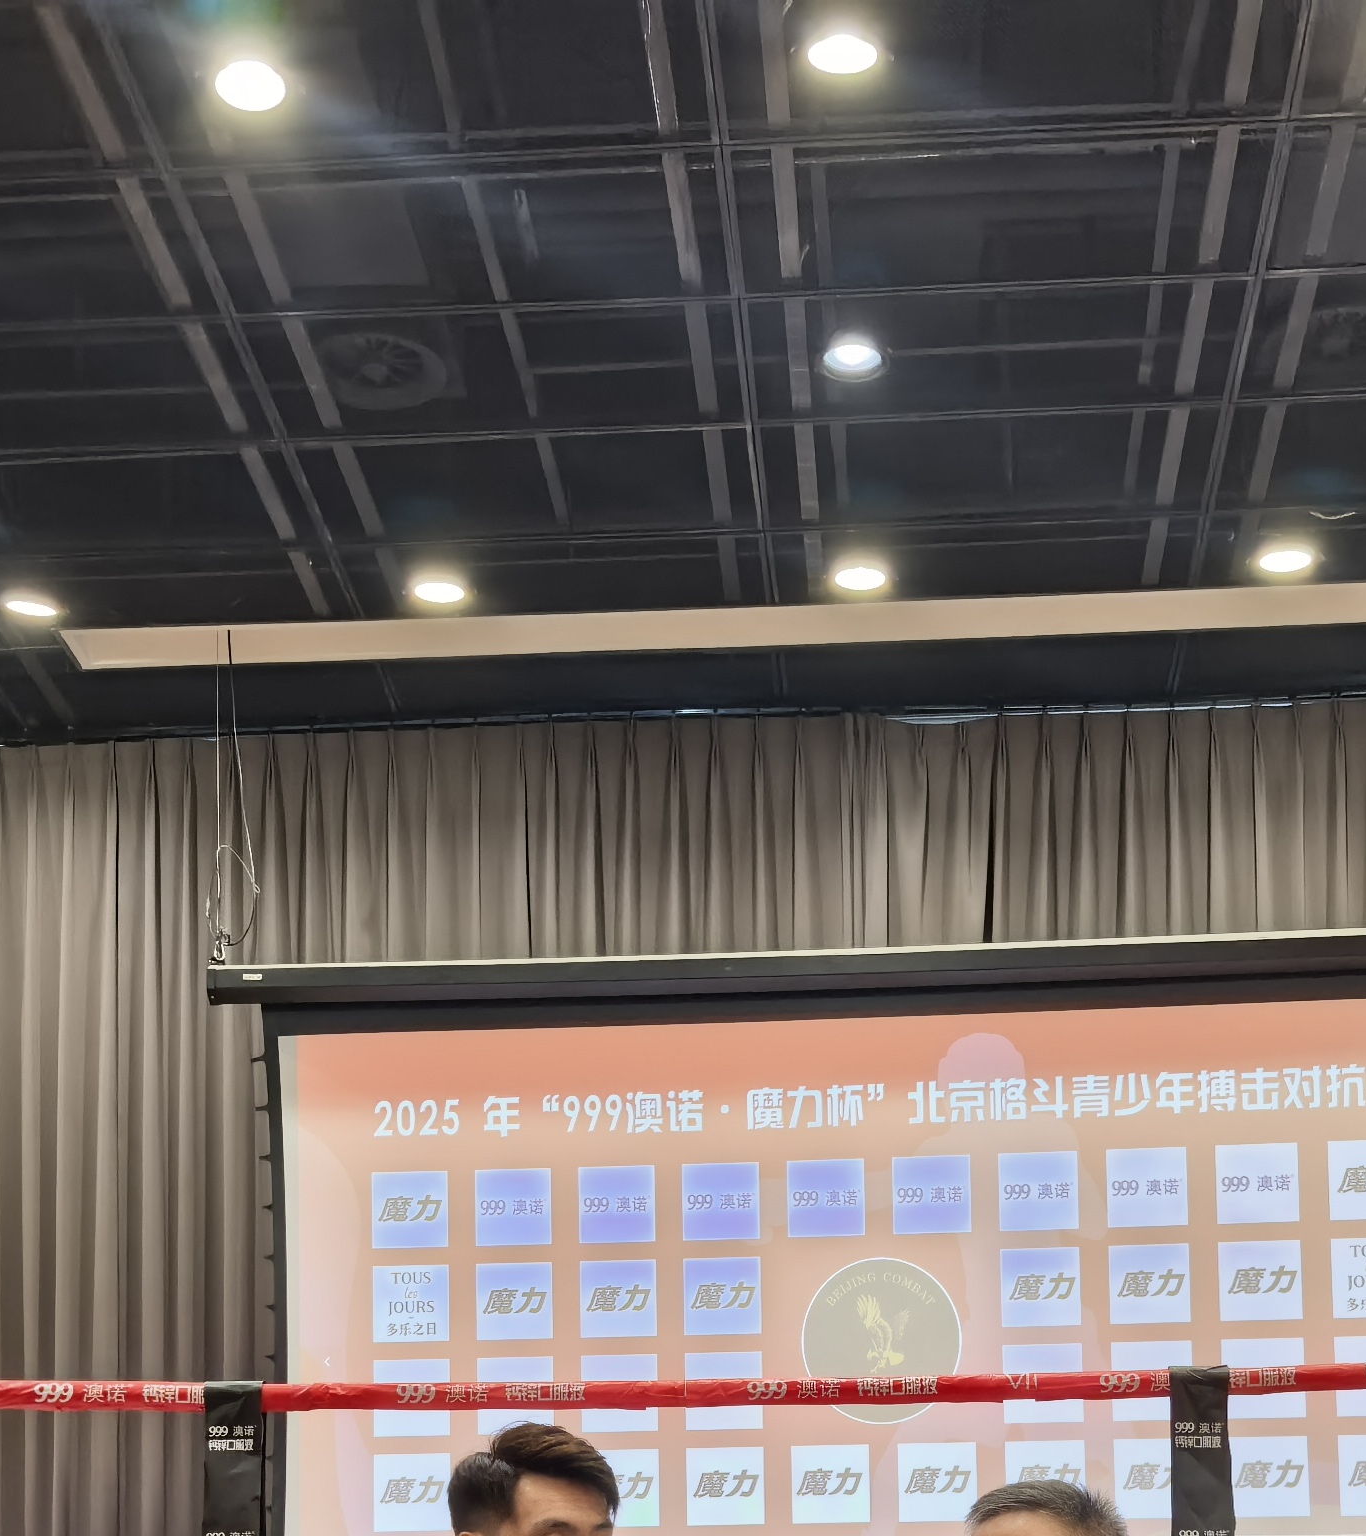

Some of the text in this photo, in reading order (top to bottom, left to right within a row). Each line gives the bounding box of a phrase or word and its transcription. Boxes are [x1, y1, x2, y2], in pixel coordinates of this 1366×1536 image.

[374, 1098, 461, 1138] 2025
[483, 1095, 521, 1138] 年
[1003, 1182, 1071, 1200] 999 澳诺
[1111, 1178, 1180, 1196] 999 澳诺
[1221, 1174, 1291, 1193] 999 澳诺
[583, 1196, 648, 1213] 999 澳诺
[687, 1192, 753, 1210] 999 澳诺
[792, 1189, 858, 1207] 999 澳诺
[897, 1186, 963, 1203] 999 澳诺
[378, 1194, 443, 1223] 魔力
[480, 1198, 544, 1216] 999 澳诺
[390, 1271, 432, 1285] TOUS
[1009, 1271, 1076, 1301] 魔力
[1117, 1268, 1185, 1298] 魔力
[1228, 1264, 1297, 1295] 魔力
[586, 1283, 651, 1312] 魔力
[690, 1281, 756, 1310] 魔力
[826, 1272, 937, 1307] BEIJING COMBAT
[388, 1299, 435, 1315] JOURS
[482, 1286, 547, 1315] 魔力
[386, 1321, 437, 1337] 多乐之日
[35, 1383, 127, 1404] 999 澳诺
[396, 1383, 585, 1404] 999 澳诺 钙锌口服液
[747, 1376, 938, 1400] 999 澳诺 钙锌口服液
[1100, 1373, 1140, 1393] 999
[209, 1425, 254, 1437] 999 澳诺
[1175, 1422, 1222, 1434] 999 澳诺
[693, 1469, 759, 1499] 魔力
[796, 1467, 864, 1497] 魔力
[905, 1465, 972, 1495] 魔力
[1234, 1459, 1304, 1489] 魔力
